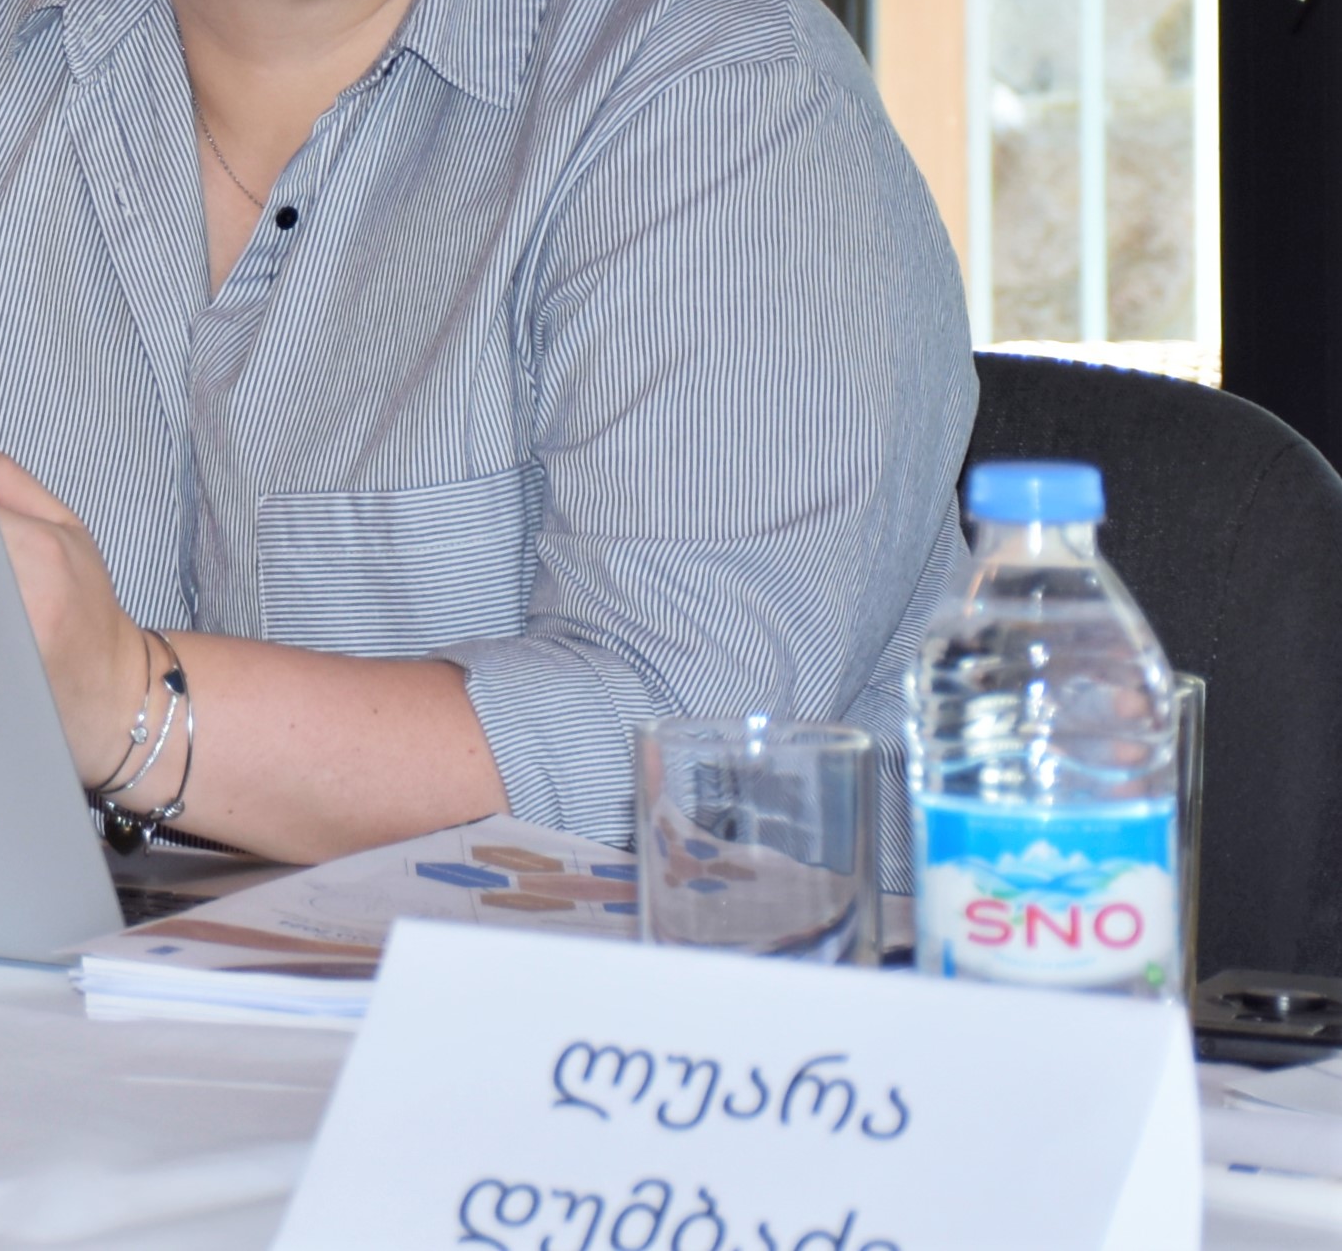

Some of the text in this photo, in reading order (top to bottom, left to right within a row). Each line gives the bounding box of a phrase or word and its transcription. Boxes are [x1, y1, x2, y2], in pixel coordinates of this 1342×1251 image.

[963, 899, 1145, 950] SNO
[552, 1040, 912, 1141] ლუარა
[457, 1177, 903, 1251] დუმბა
